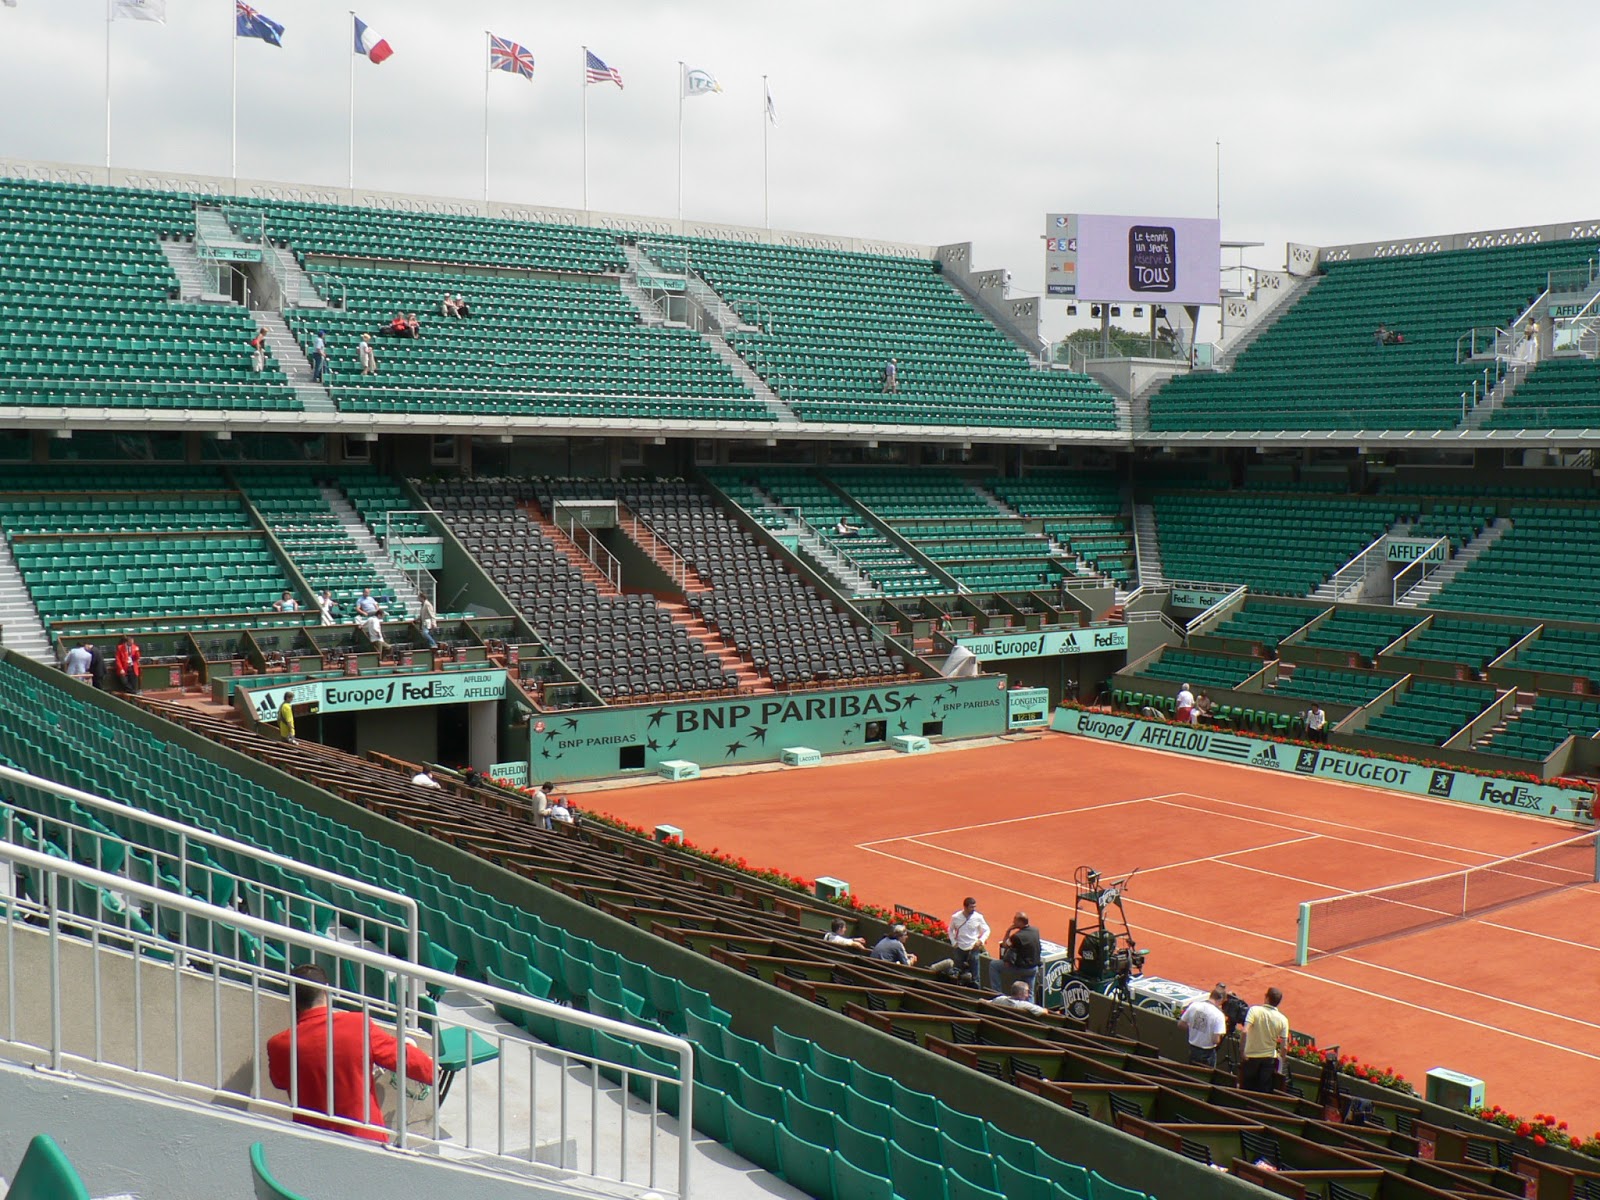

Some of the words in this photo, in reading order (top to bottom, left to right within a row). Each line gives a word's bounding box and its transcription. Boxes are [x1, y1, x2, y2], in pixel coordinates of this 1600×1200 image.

[1134, 232, 1143, 241] Le
[1145, 231, 1169, 242] tennis
[1135, 244, 1146, 252] un
[1149, 243, 1169, 254] sport
[1134, 266, 1170, 284] TOUS
[1094, 632, 1125, 648] FedEx
[1059, 645, 1081, 654] adidas
[464, 675, 492, 683] AFFLELOU
[402, 681, 455, 700] FedEx
[464, 686, 505, 698] AFFLELOU
[943, 703, 962, 711] BNP
[963, 699, 1000, 709] PARIBAS
[1010, 697, 1047, 706] LONGINES
[676, 705, 751, 733] BNP
[761, 691, 901, 725] PARIBAS
[559, 740, 584, 749] BNP
[587, 734, 637, 746] PARIBAS
[1140, 726, 1209, 752] AFFLELOU
[1251, 756, 1280, 768] adidas
[492, 765, 527, 777] AFFLELOU
[1320, 757, 1411, 785] PEUGEOT
[1480, 781, 1542, 811] FedEx
